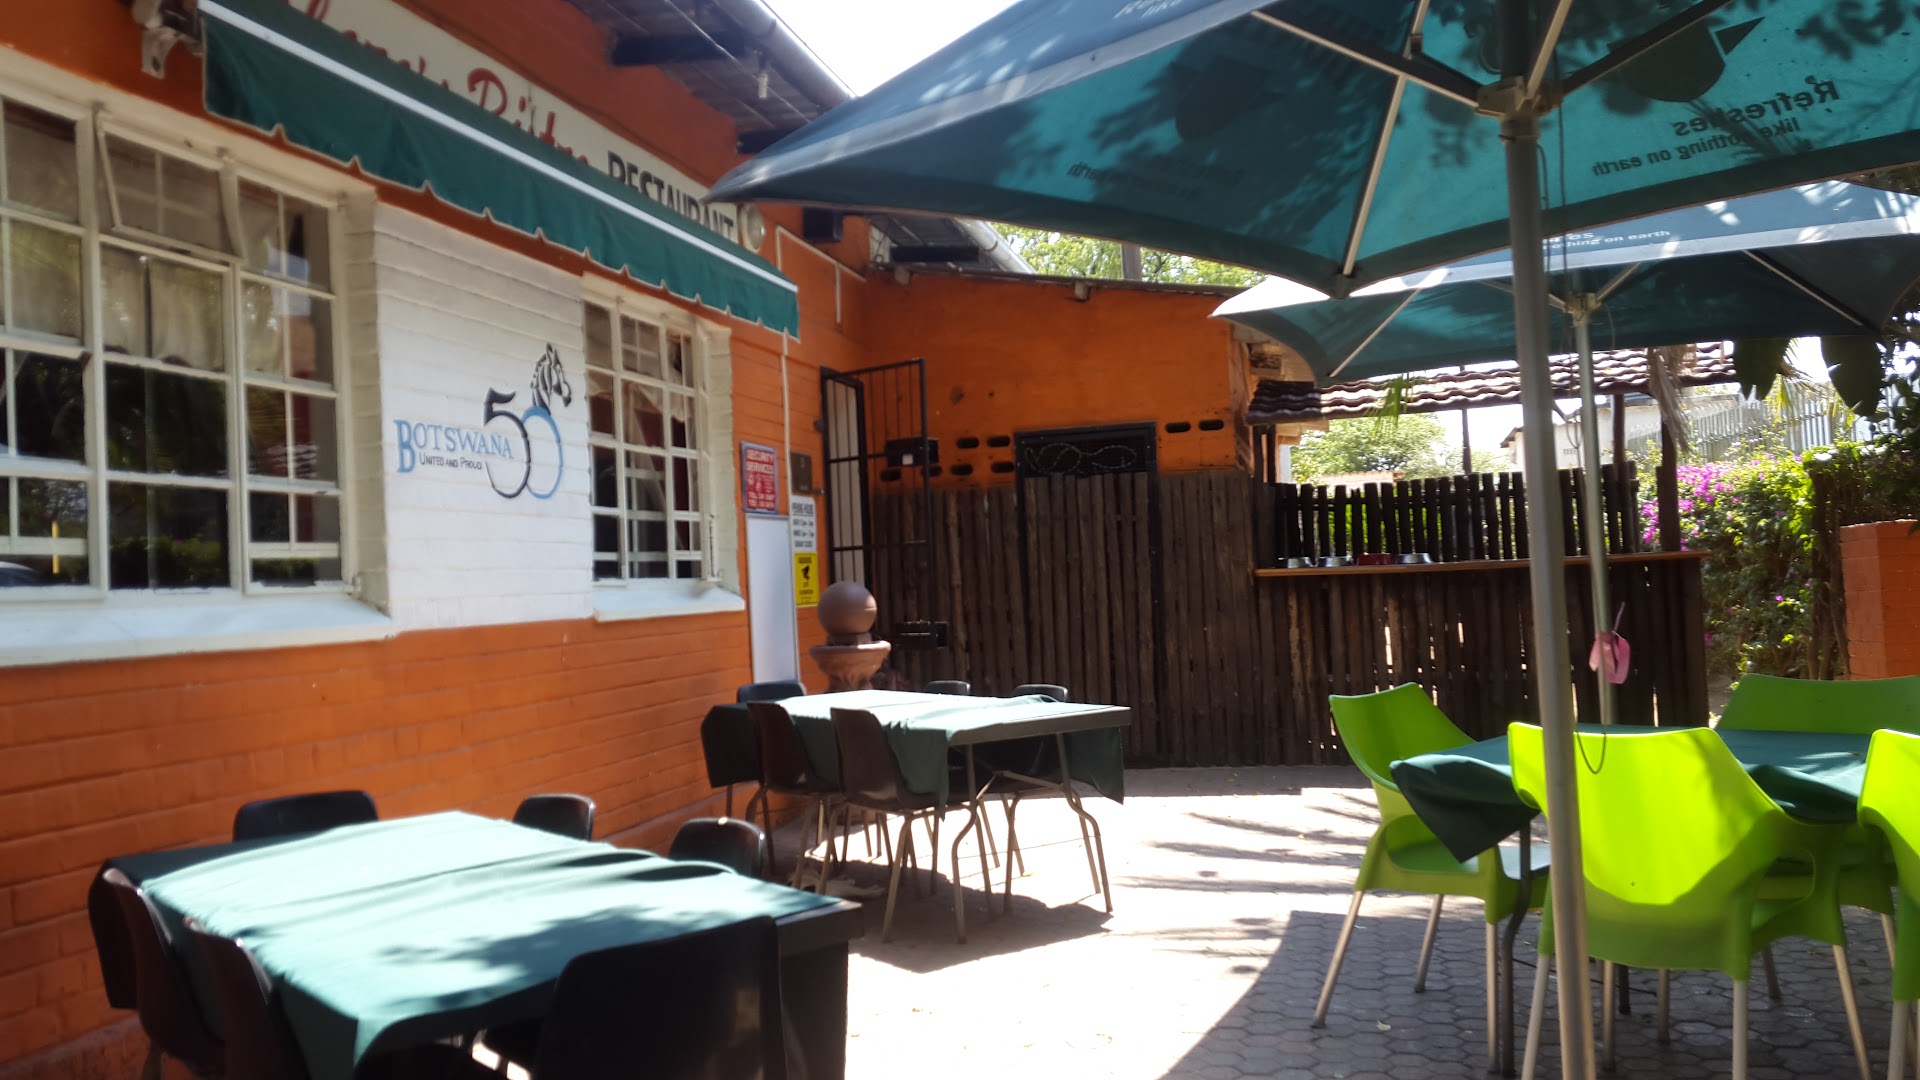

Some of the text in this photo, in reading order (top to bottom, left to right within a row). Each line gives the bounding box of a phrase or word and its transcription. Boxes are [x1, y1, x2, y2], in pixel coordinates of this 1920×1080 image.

[1543, 238, 1601, 250] ohing
[1604, 235, 1624, 243] on
[1627, 230, 1671, 240] earth
[393, 419, 514, 473] BOTSWANA
[418, 451, 483, 471] UNITED AND PROUD
[483, 386, 564, 500] 50
